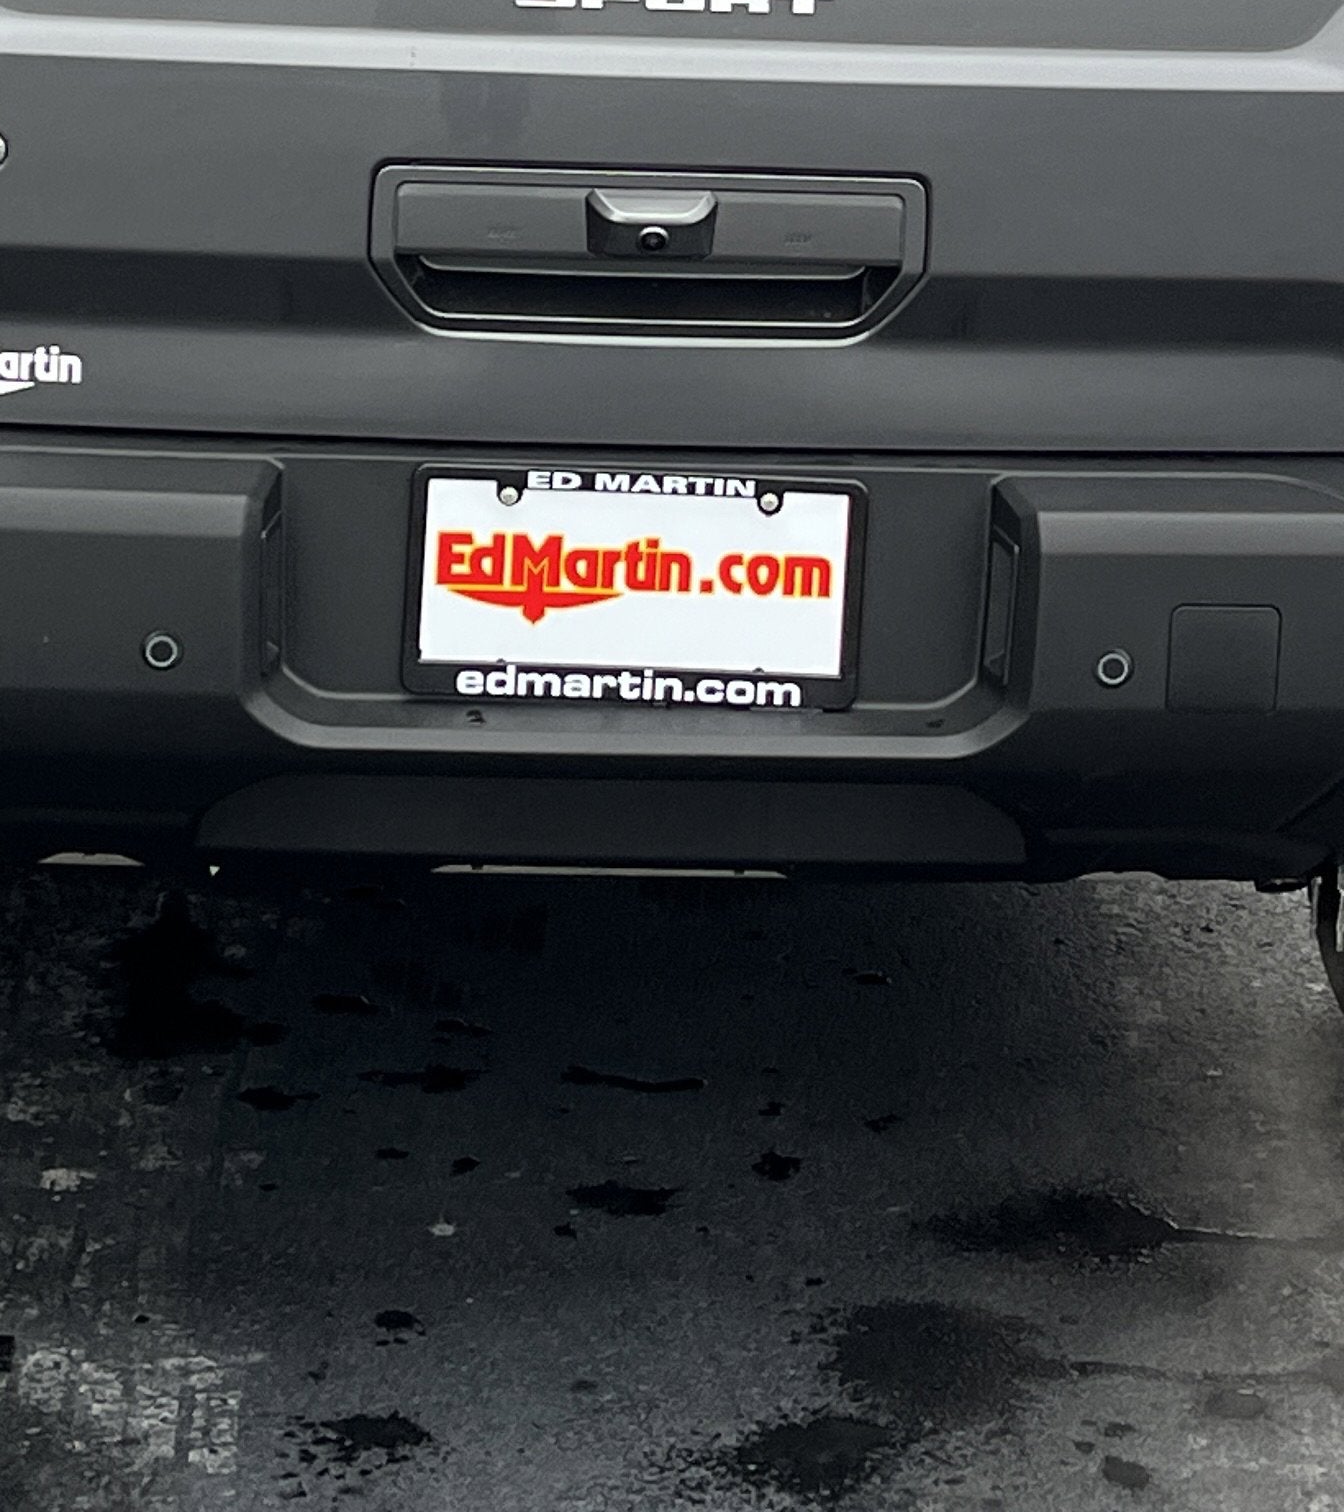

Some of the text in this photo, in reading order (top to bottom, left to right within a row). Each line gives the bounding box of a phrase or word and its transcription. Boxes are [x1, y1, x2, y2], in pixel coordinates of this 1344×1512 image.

[526, 470, 757, 498] ED MARTIN
[436, 531, 832, 598] EdMartin.com
[455, 664, 802, 708] edmartin.com
